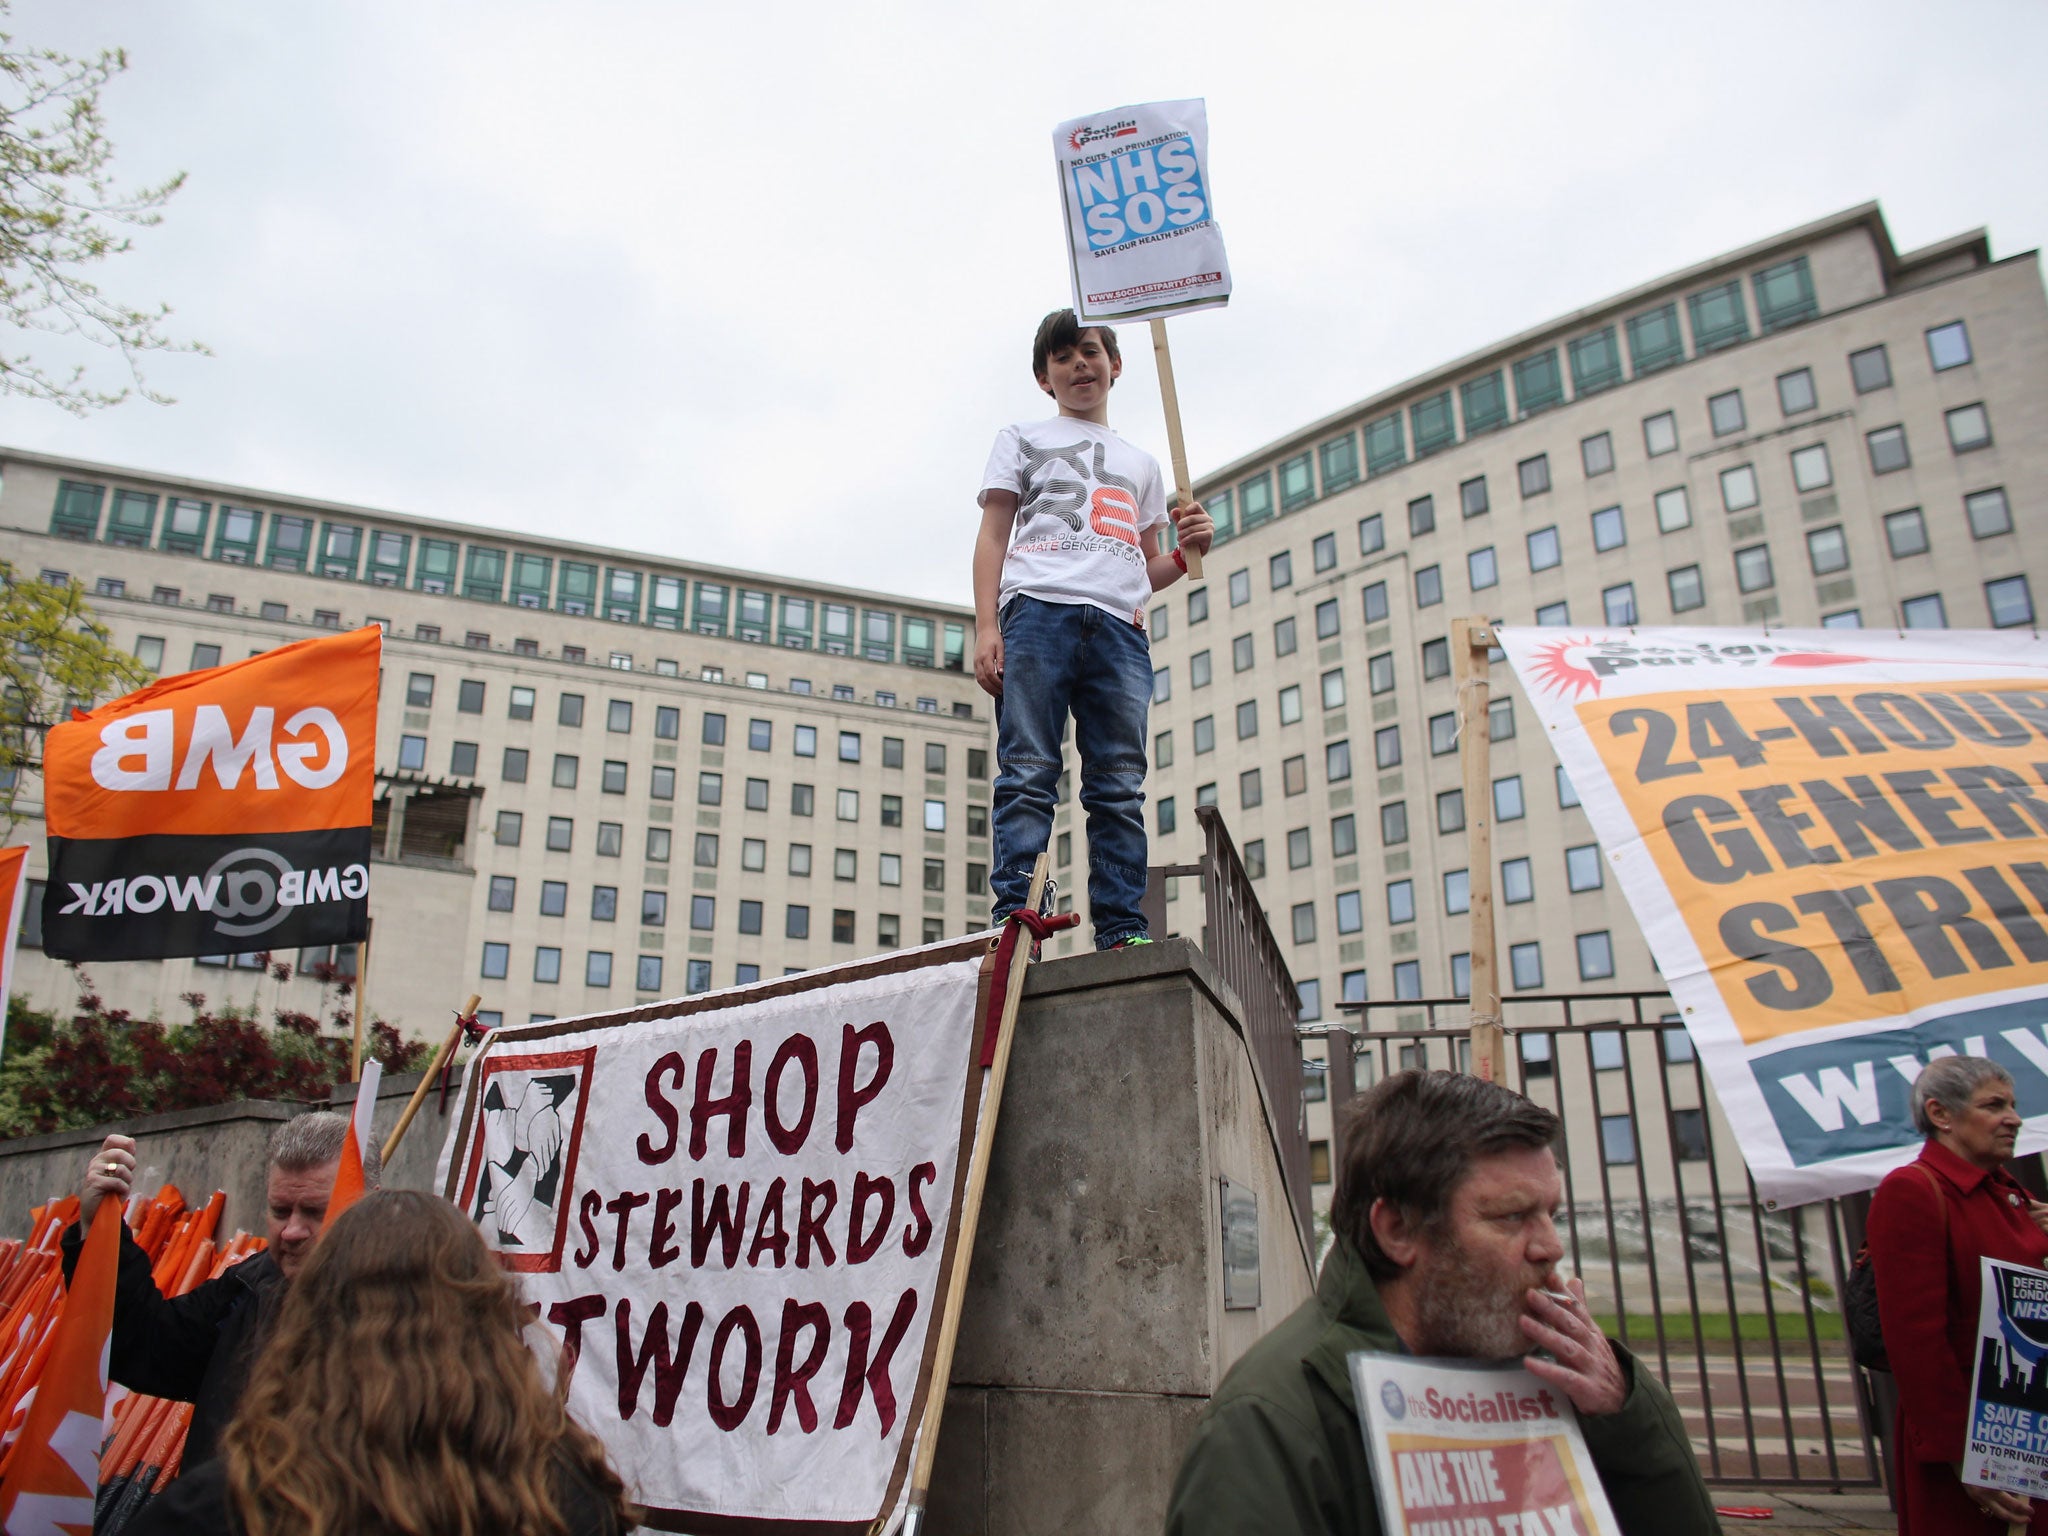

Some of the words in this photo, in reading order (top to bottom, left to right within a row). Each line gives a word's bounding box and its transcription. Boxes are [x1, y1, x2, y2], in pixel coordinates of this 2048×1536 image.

[1083, 120, 1136, 137] Socialist
[1071, 159, 1083, 167] NO
[1111, 147, 1124, 157] NO
[1125, 130, 1189, 151] PRIVATISATION
[1075, 140, 1197, 207] NHS
[1086, 181, 1205, 247] SOS
[1094, 246, 1117, 259] SAVE
[1118, 241, 1137, 251] OUR
[1138, 232, 1171, 245] HEALTH
[1173, 220, 1210, 237] SERVICE
[1089, 273, 1218, 302] WWW.SOCIALISTPARTY.ORG.UK
[1061, 540, 1138, 566] GENERATION
[1662, 762, 2048, 885] GENER
[637, 1020, 895, 1165] SHOP
[574, 1161, 937, 1271] STEWARDS
[1408, 1394, 1428, 1419] the
[1425, 1387, 1560, 1424] Socialist
[1983, 1403, 2032, 1430] SAVE
[1971, 1442, 1987, 1454] NO
[1989, 1445, 2001, 1457] TO
[1397, 1451, 1456, 1509] AXE
[1446, 1449, 1506, 1504] THE
